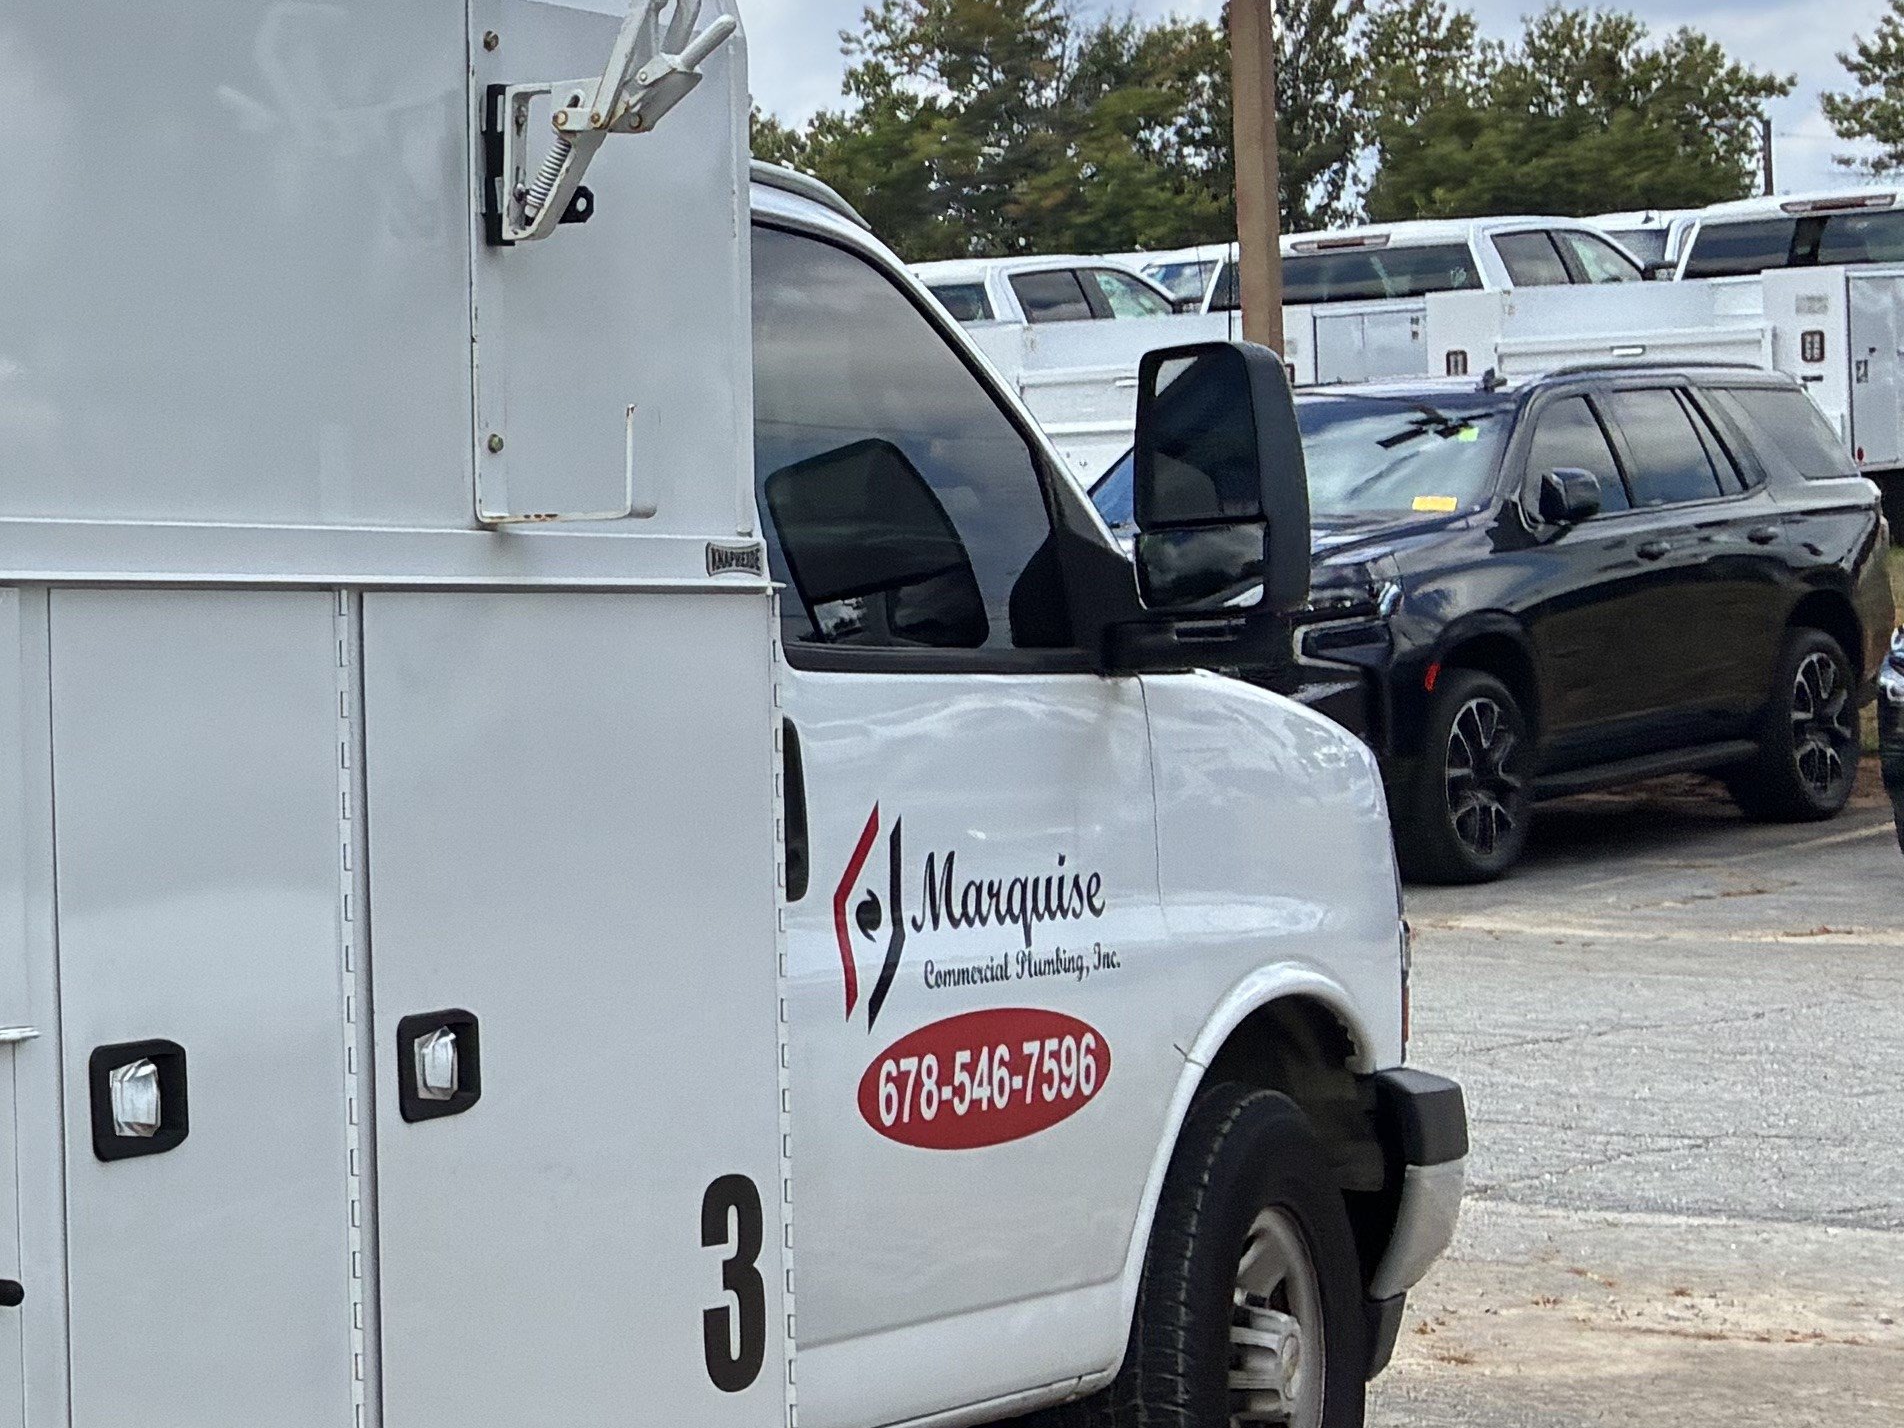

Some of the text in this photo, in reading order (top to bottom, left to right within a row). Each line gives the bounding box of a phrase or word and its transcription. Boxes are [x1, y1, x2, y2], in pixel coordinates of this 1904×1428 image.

[911, 851, 1106, 947] Marquise
[924, 942, 1122, 990] Commercial Plumbing, Inc.
[878, 1031, 1097, 1128] 678-546-7596
[701, 1173, 766, 1392] 3
